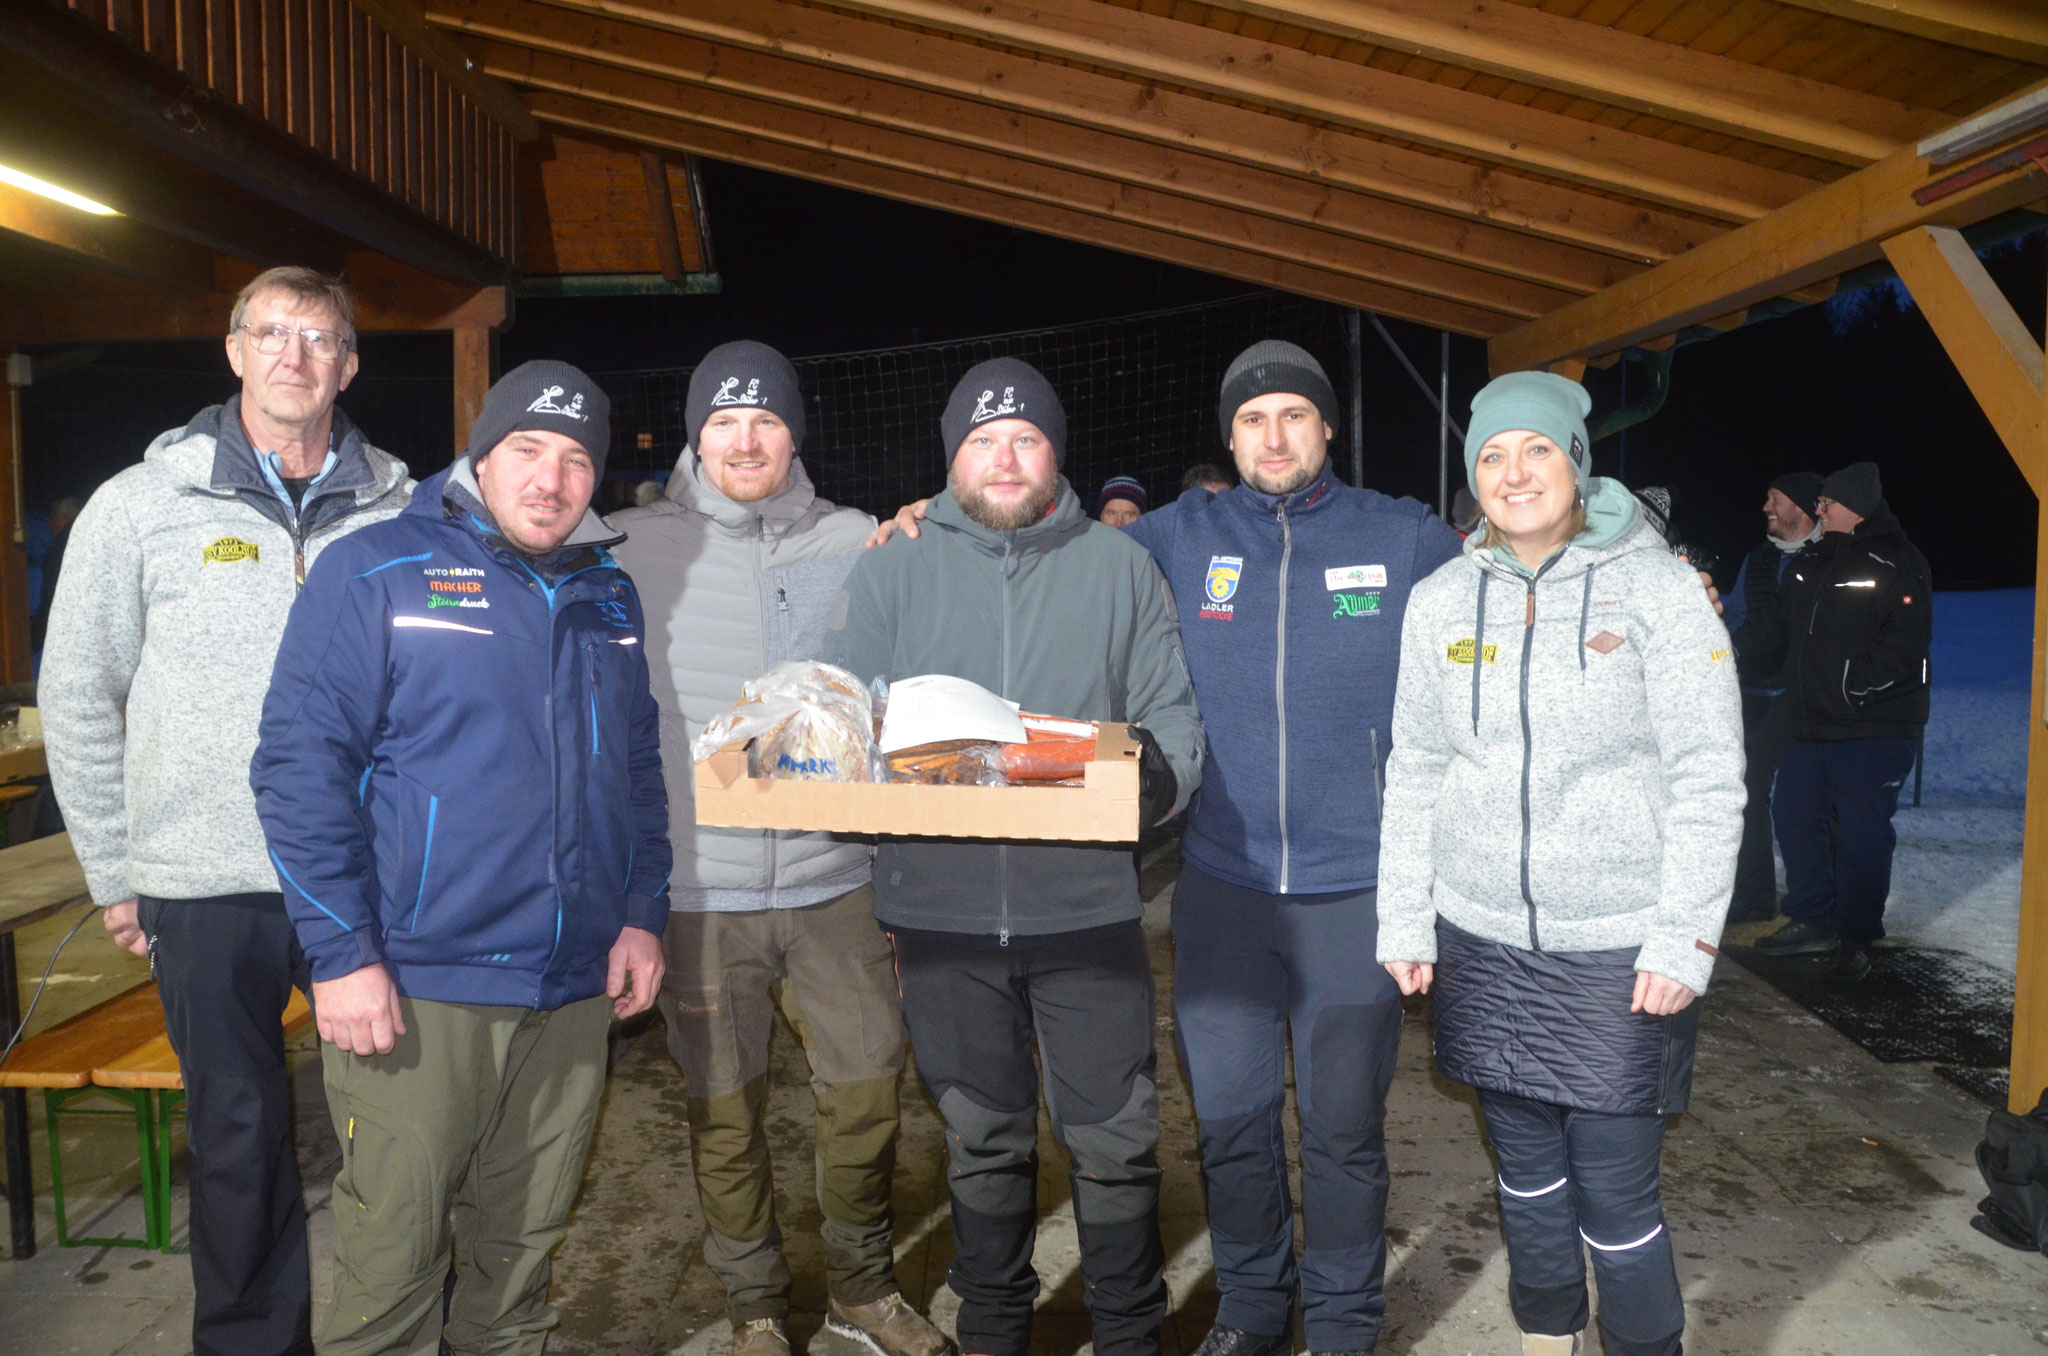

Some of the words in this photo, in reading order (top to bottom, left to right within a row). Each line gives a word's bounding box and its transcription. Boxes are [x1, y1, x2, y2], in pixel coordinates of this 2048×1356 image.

[423, 568, 449, 576] AUTO
[454, 567, 485, 577] RAITH
[429, 580, 482, 593] MACHER
[1201, 602, 1234, 613] LADLER
